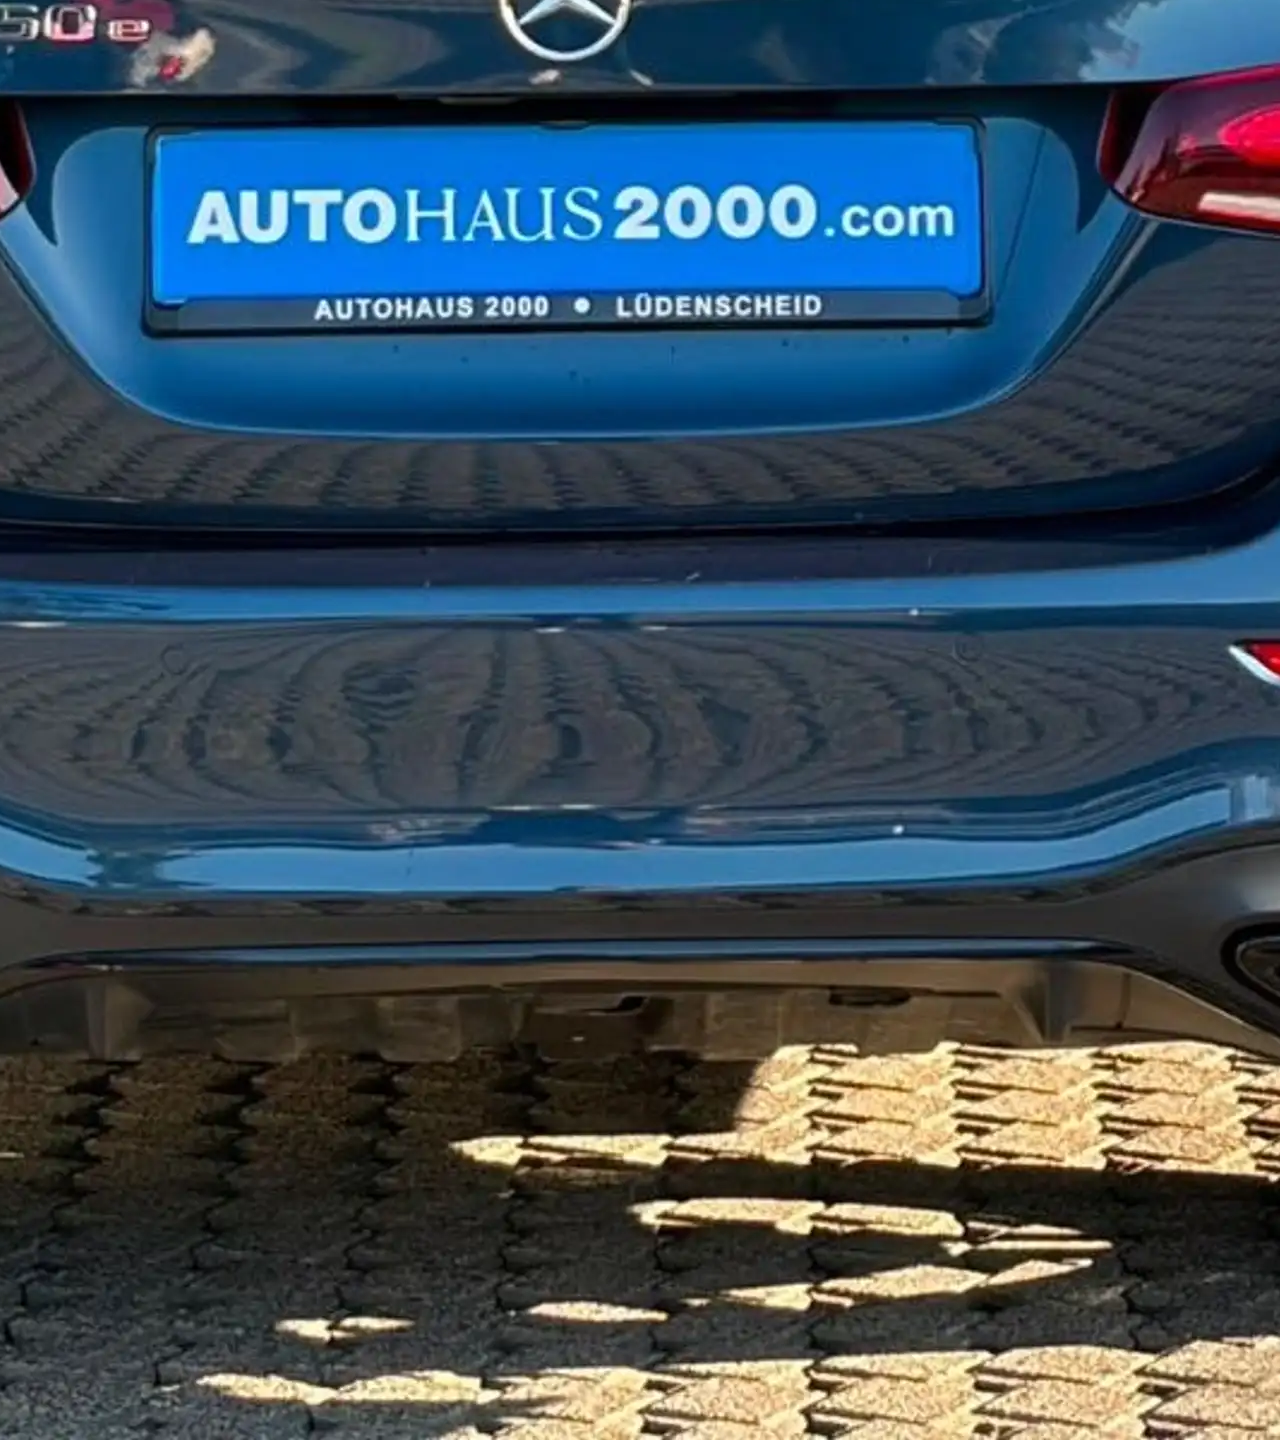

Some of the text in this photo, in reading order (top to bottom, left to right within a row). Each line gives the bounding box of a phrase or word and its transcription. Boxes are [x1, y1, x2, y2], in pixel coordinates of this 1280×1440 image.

[314, 292, 823, 321] AUTOHAUS 2000 LÜDENSCHEID
